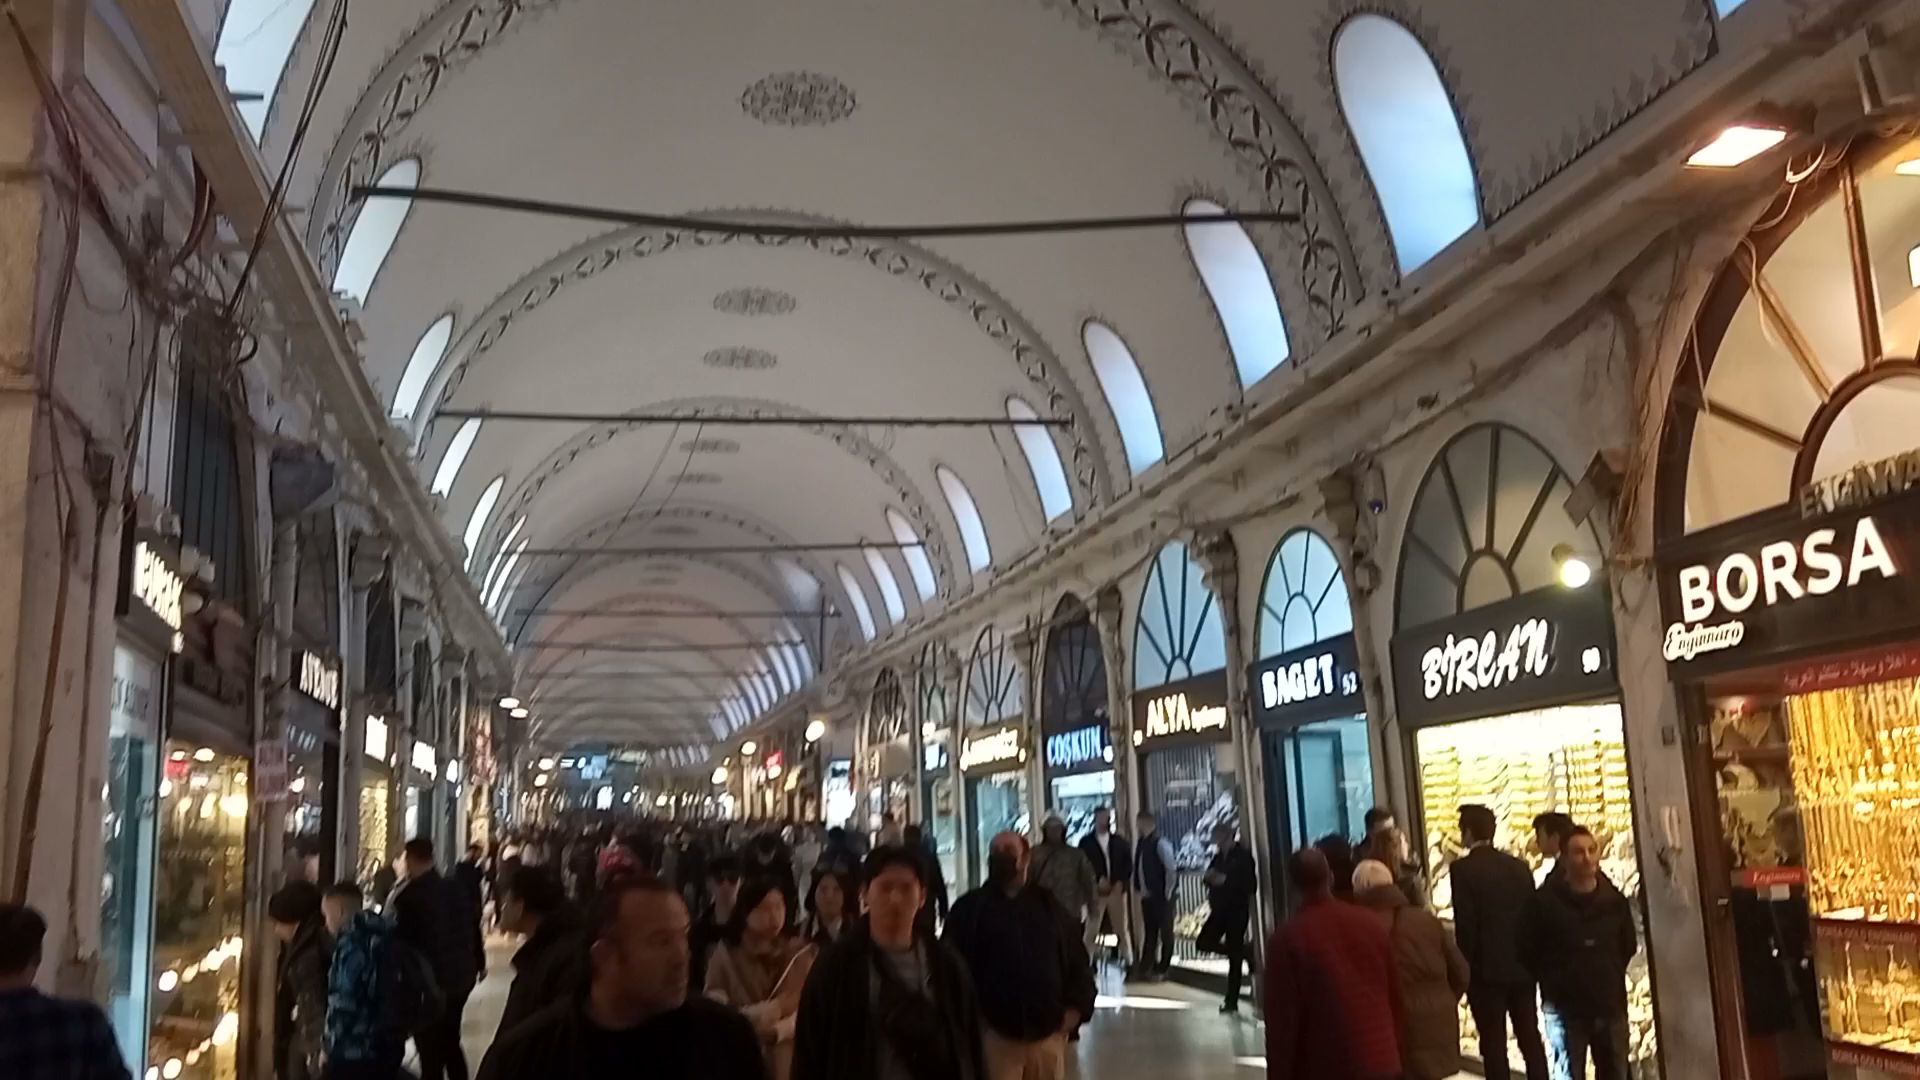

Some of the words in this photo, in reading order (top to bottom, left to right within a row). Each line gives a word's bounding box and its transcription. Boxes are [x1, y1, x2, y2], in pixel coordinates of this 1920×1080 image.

[1679, 516, 1898, 624] BORSA
[1262, 653, 1334, 709] BAGET
[1421, 618, 1549, 700] BİRCAN
[1146, 692, 1191, 738] ALYA
[1046, 725, 1102, 770] COŞKUN
